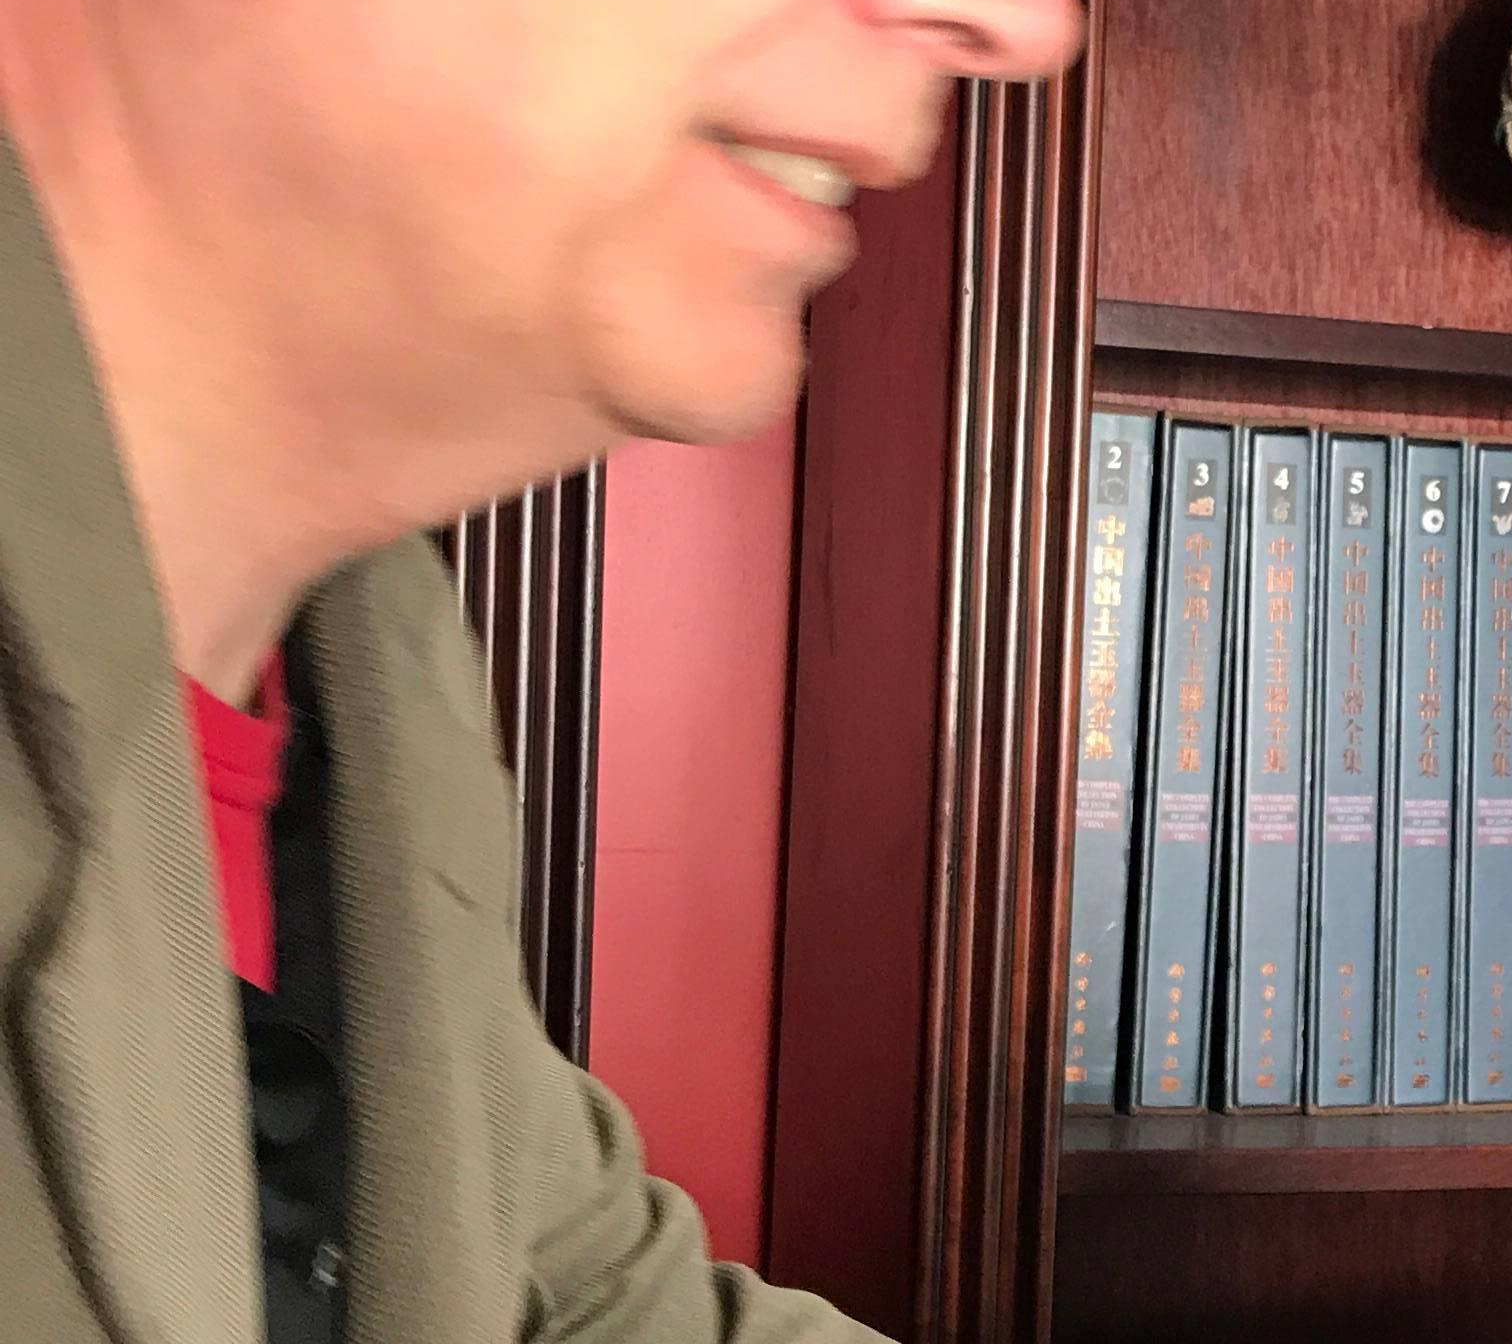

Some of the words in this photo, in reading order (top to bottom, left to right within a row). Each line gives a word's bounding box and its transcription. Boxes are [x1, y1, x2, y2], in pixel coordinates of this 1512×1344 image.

[1107, 446, 1123, 469] 2
[1193, 463, 1209, 487] 3
[1273, 467, 1289, 490] 4
[1349, 471, 1365, 494] 5
[1426, 480, 1441, 502] 6
[1496, 481, 1512, 504] 7
